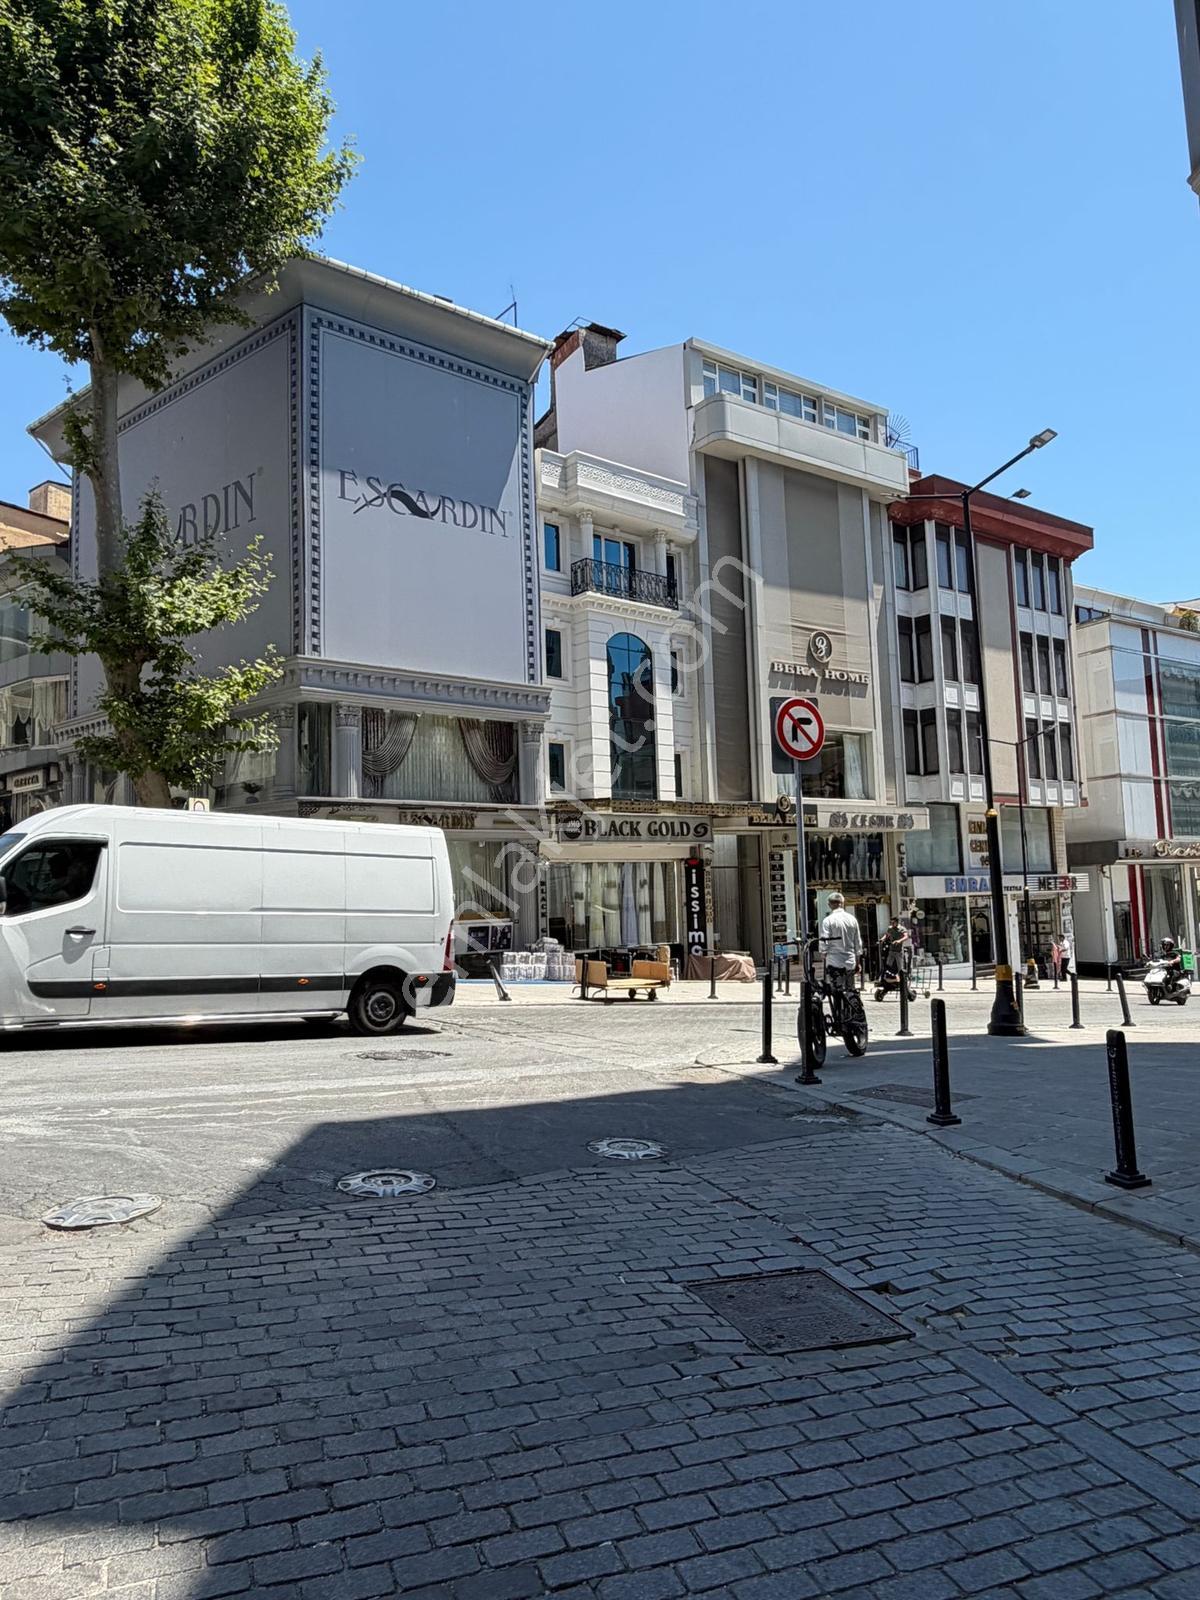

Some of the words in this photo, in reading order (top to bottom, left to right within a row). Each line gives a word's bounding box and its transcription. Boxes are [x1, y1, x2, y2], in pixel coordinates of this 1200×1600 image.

[773, 662, 819, 677] BERA
[824, 669, 871, 684] HOME
[584, 819, 642, 837] BLACK
[647, 821, 691, 837] GOLD
